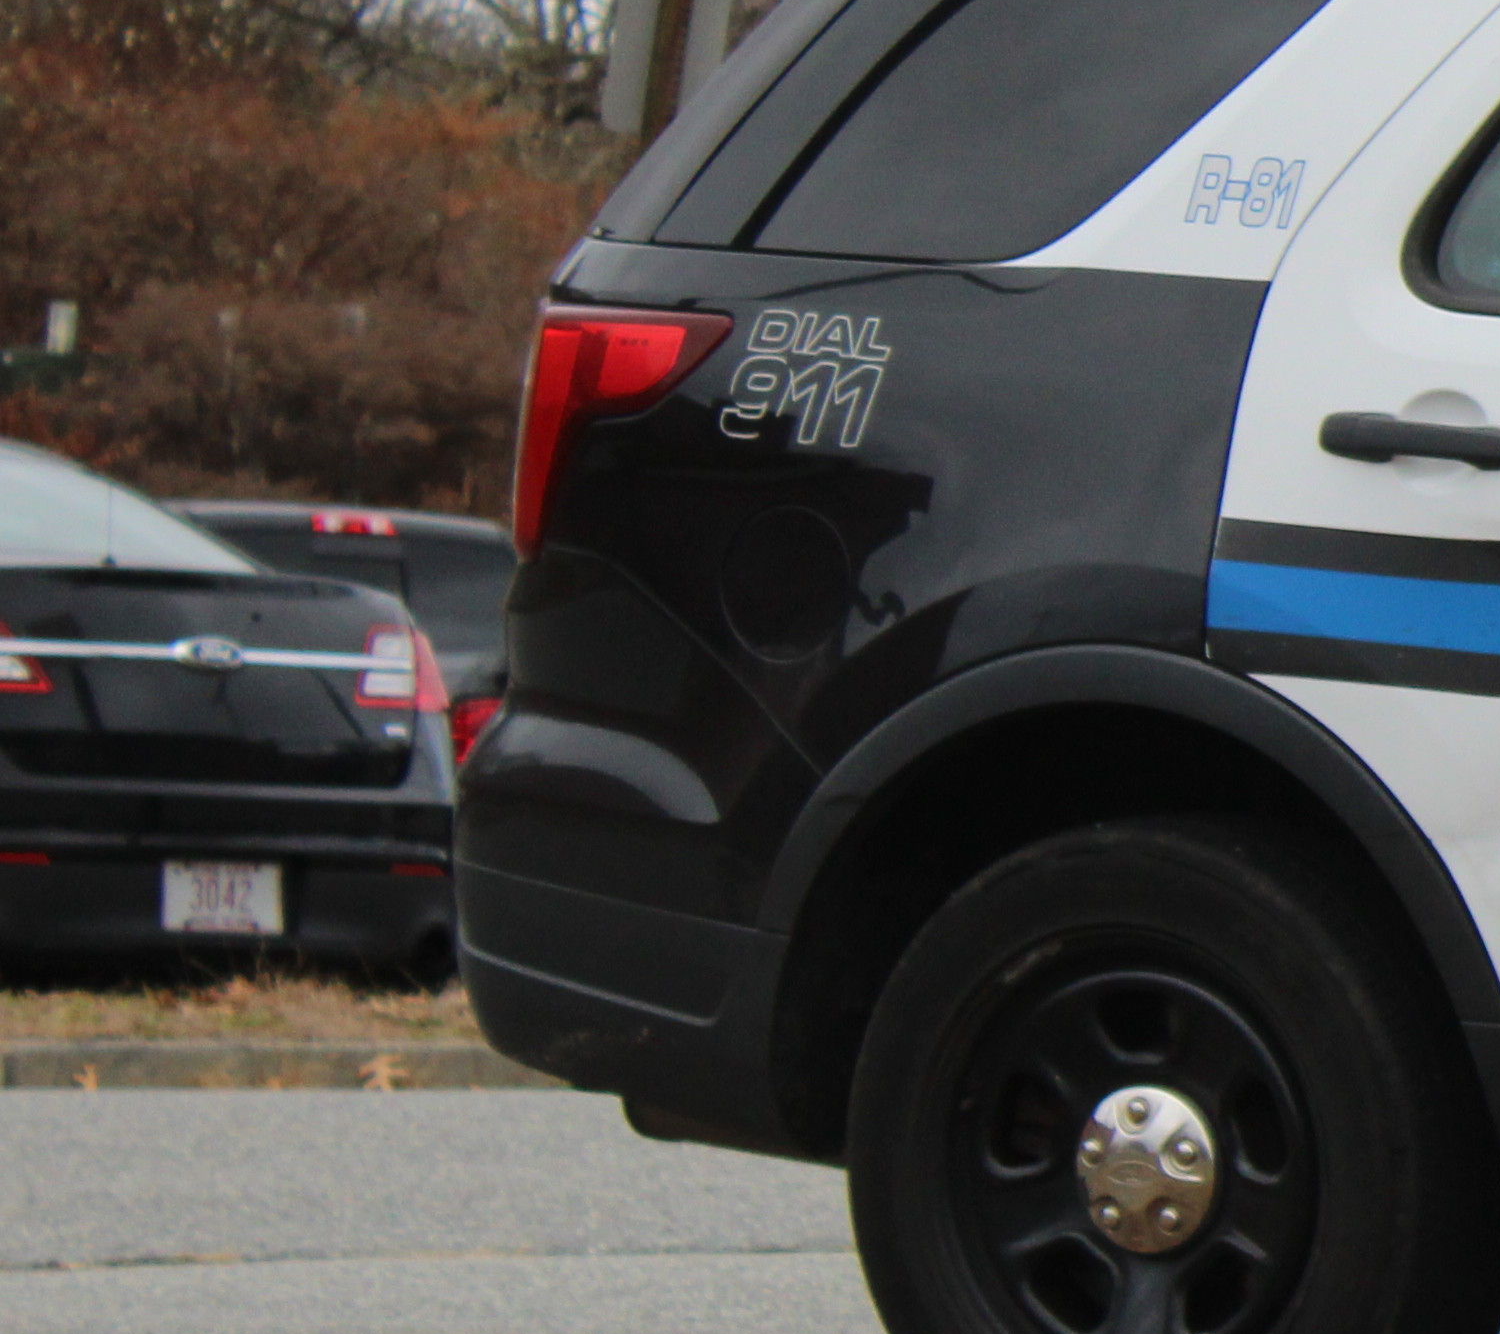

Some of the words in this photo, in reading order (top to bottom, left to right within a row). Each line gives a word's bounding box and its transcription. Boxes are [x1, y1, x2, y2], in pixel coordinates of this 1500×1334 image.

[1184, 153, 1306, 230] R-81
[747, 309, 891, 362] DIAL
[719, 354, 885, 448] 911
[190, 877, 254, 913] 3042
